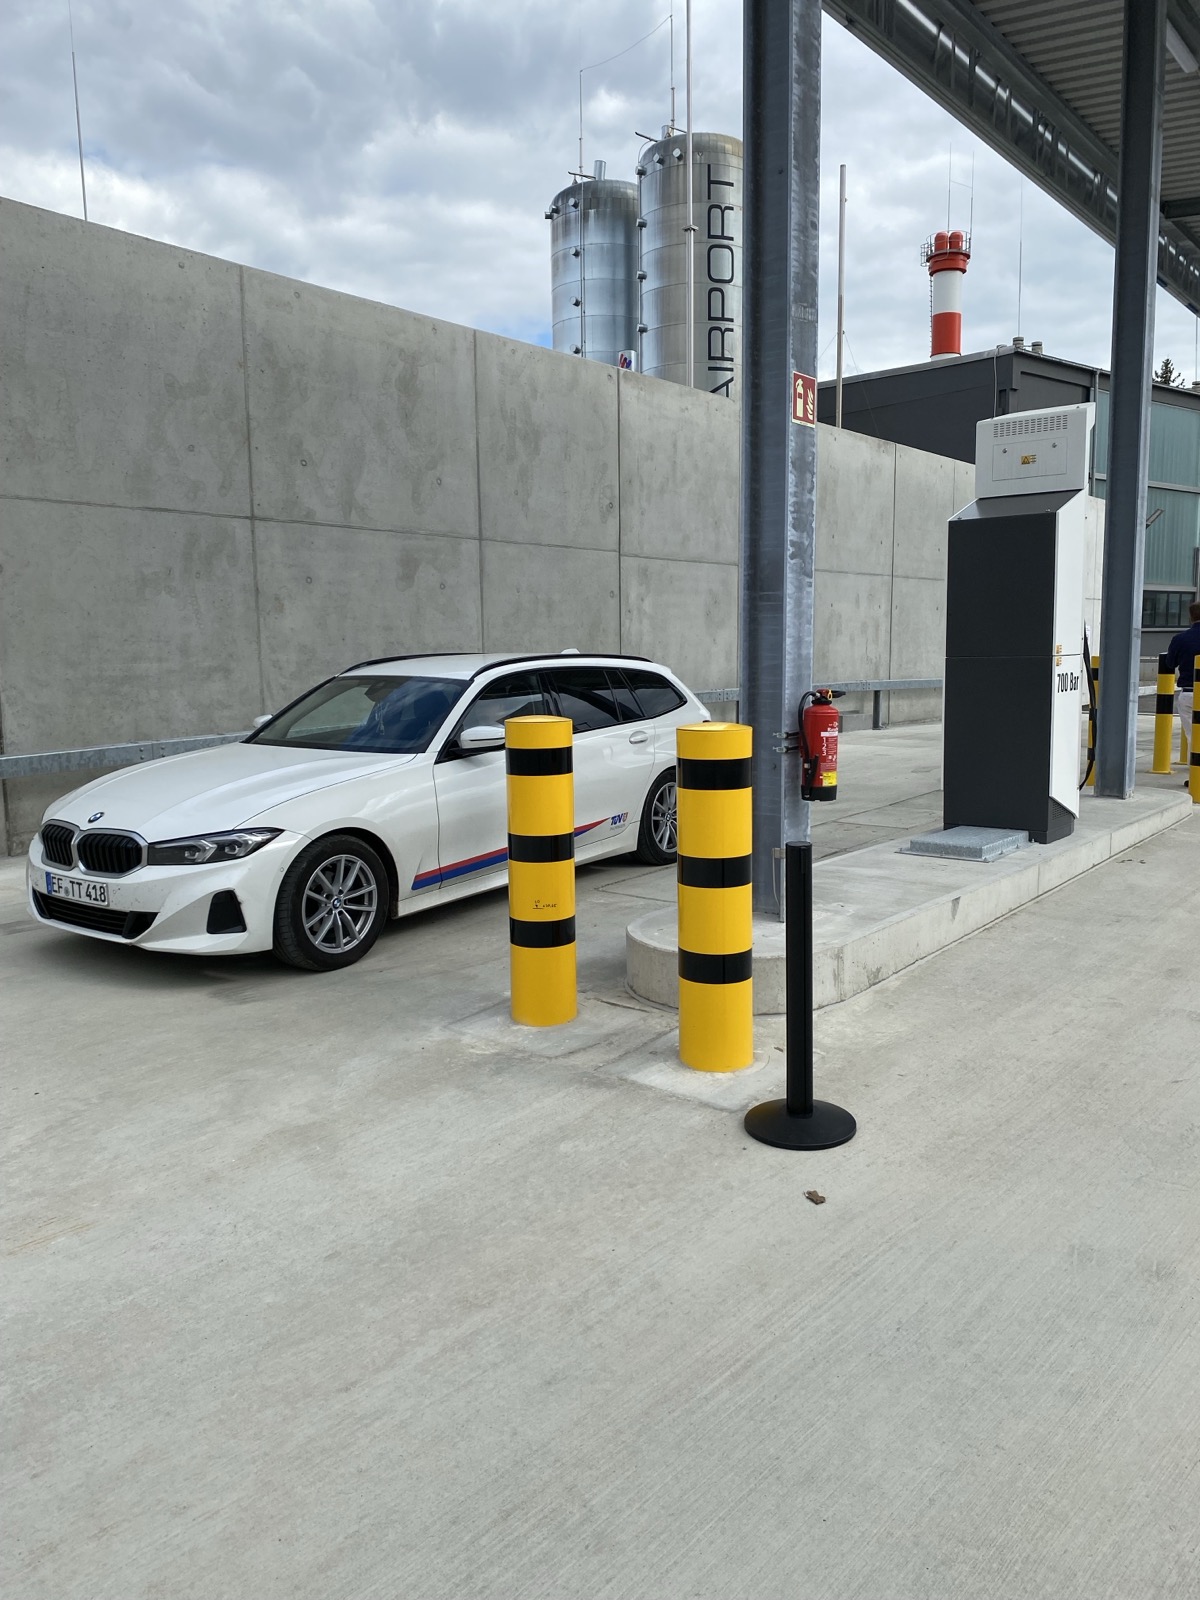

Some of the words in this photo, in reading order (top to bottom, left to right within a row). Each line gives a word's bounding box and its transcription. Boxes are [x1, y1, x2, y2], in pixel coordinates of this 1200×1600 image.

[1057, 672, 1068, 693] 700
[1070, 672, 1079, 691] Bar
[51, 876, 63, 893] EF
[69, 880, 82, 898] TT
[85, 884, 106, 902] 418
